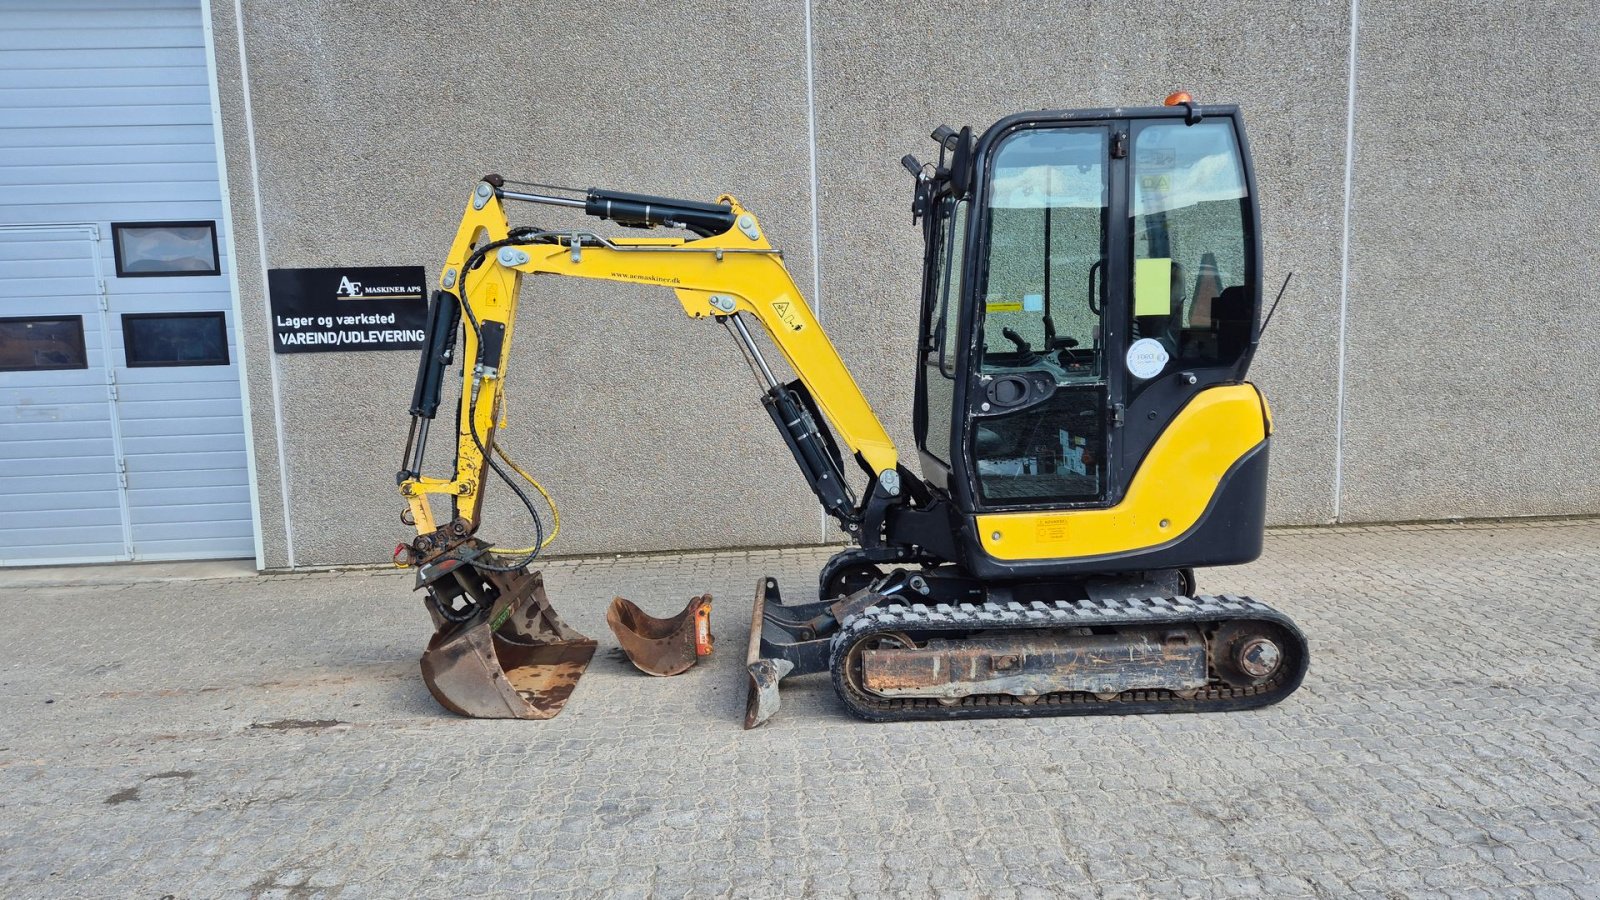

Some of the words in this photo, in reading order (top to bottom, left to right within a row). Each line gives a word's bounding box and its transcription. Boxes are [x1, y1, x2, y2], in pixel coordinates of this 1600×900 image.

[336, 275, 363, 297] AE
[365, 286, 405, 294] MASKINER
[406, 285, 421, 293] APS
[277, 315, 314, 328] Lager
[317, 315, 333, 328] og
[336, 313, 396, 325] værksted
[279, 329, 425, 345] VAREIND/UDLEVERING
